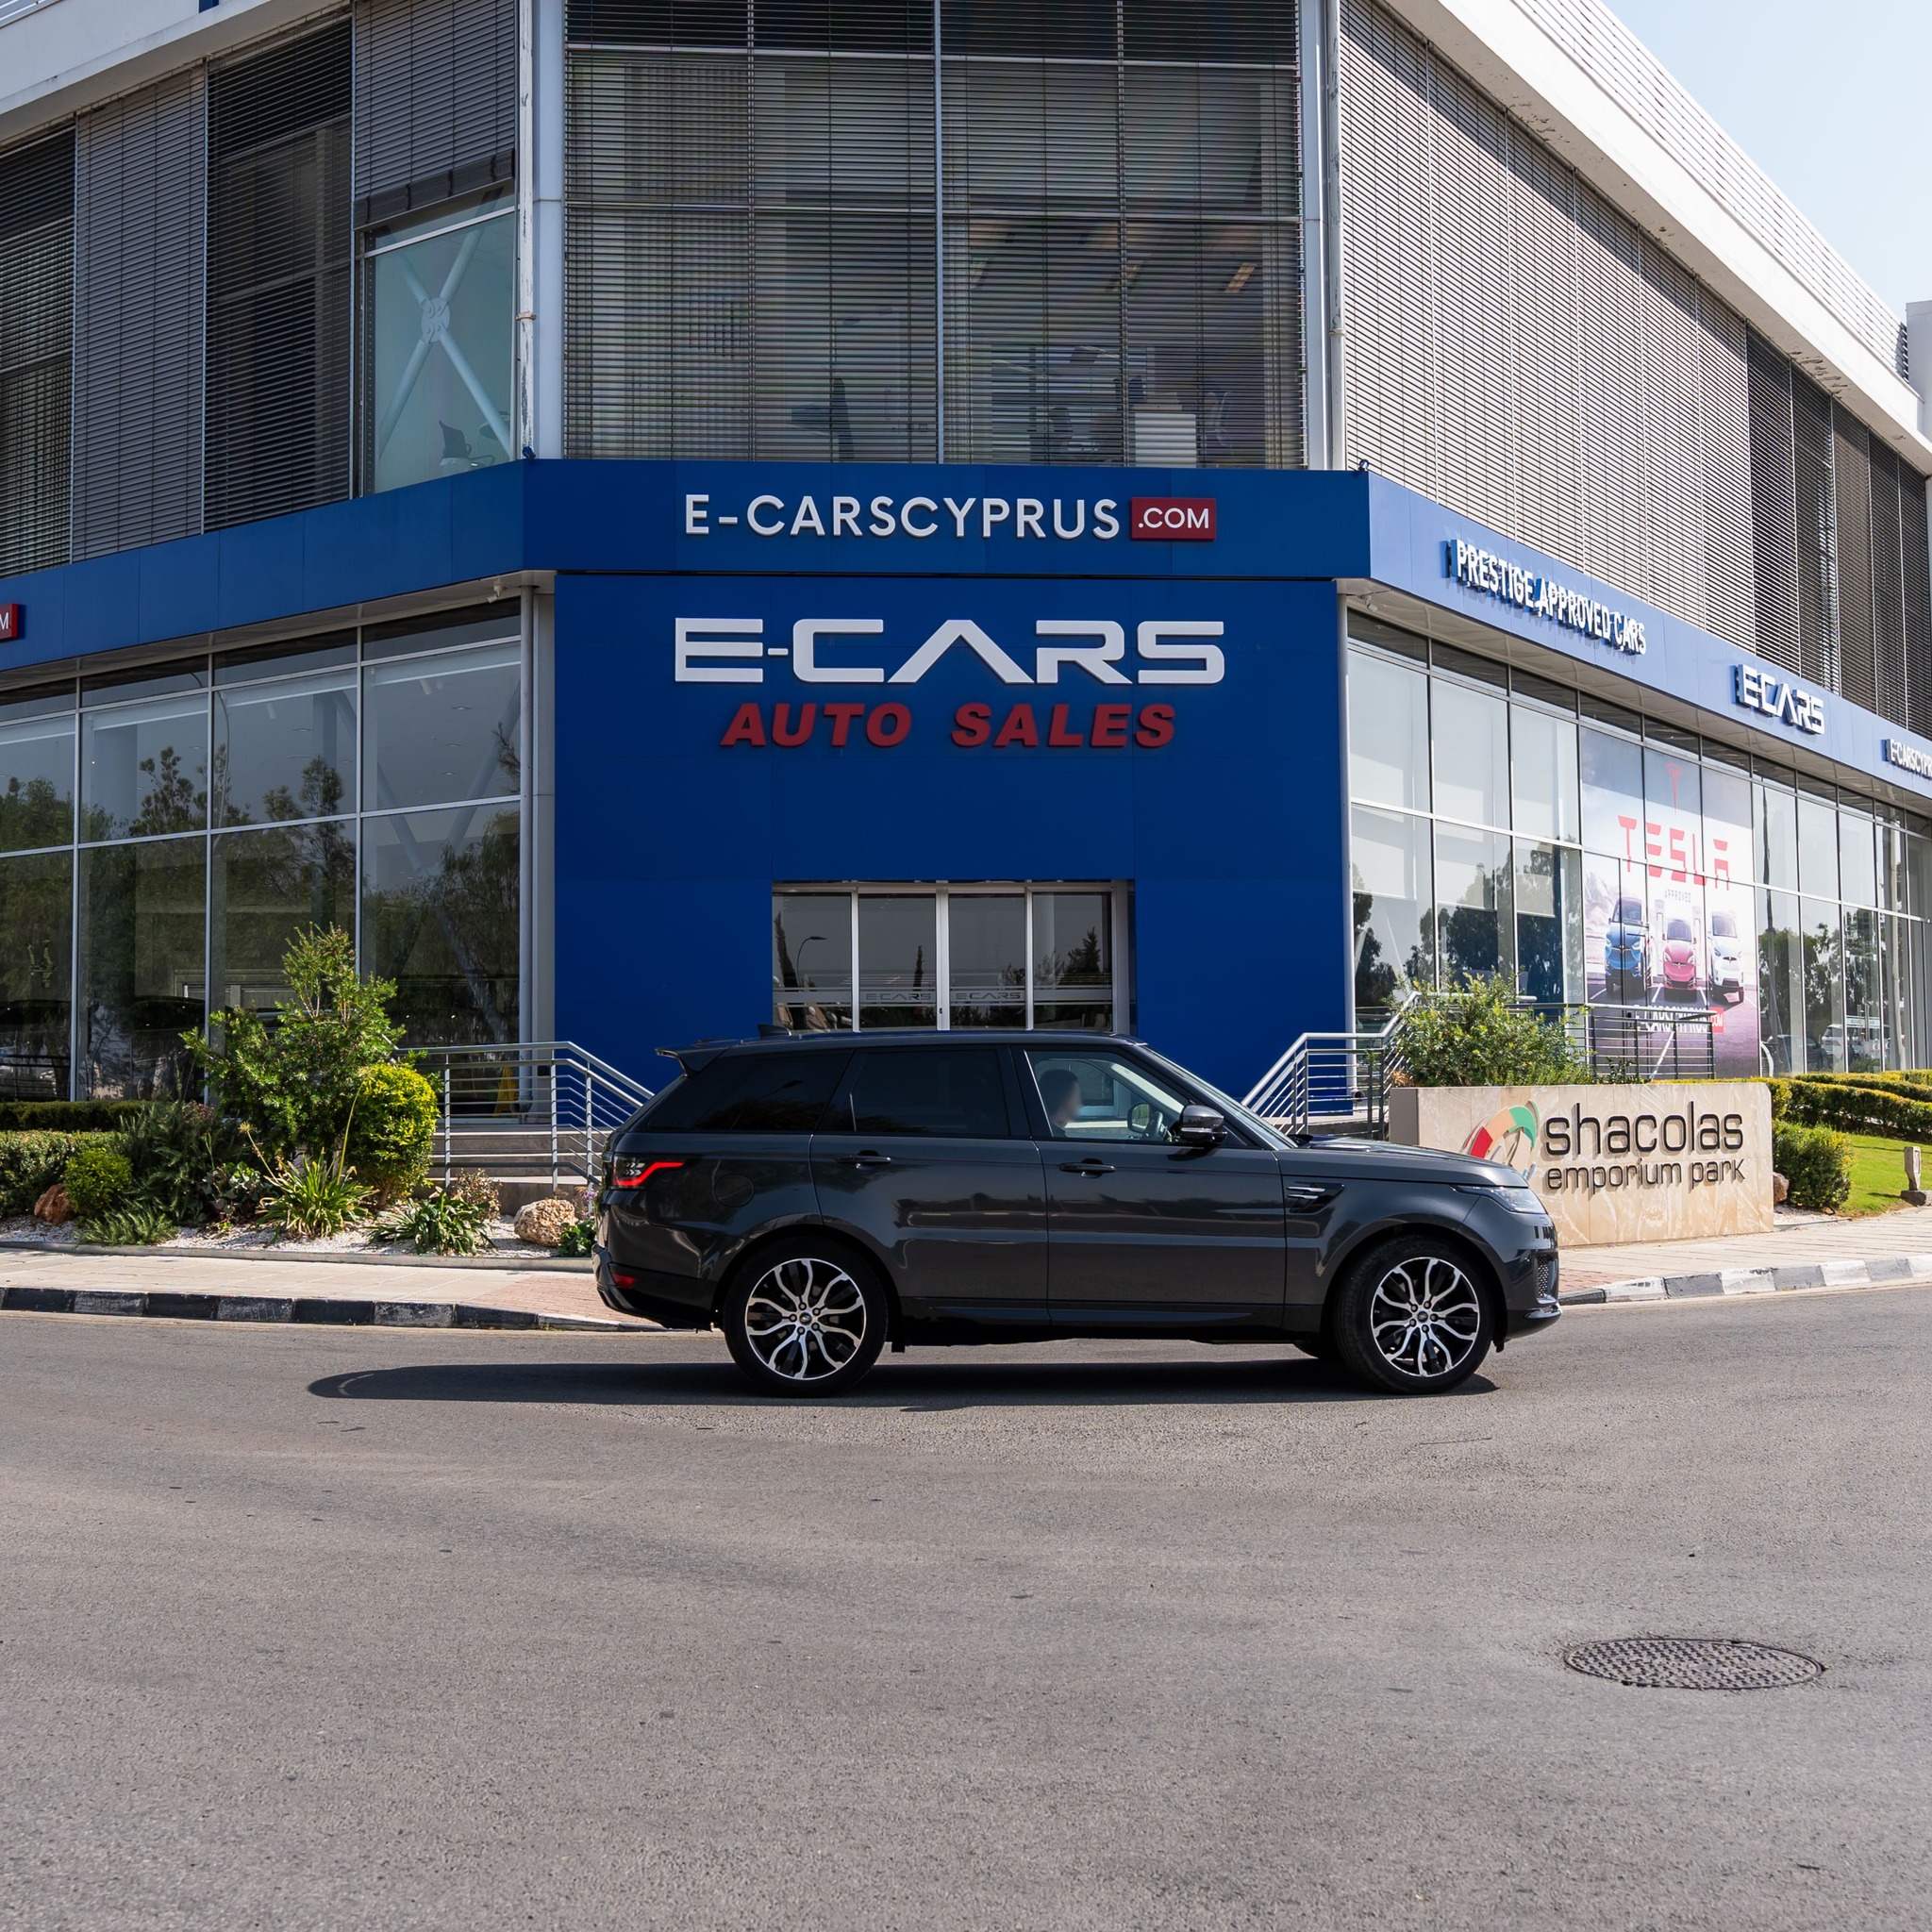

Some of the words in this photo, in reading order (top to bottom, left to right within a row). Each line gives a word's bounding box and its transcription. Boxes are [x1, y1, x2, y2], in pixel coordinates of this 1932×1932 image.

[686, 494, 1120, 539] E-CARSCYPRUS
[1138, 507, 1209, 529] .COM
[1454, 539, 1534, 608] PRESTIGE
[1535, 577, 1611, 642] APPROVED
[1614, 610, 1646, 656] CARS
[675, 617, 1224, 685] E-CARS
[721, 702, 912, 748] AUTO
[951, 703, 1176, 749] SALES
[1617, 814, 1730, 891] TESLA
[1545, 1101, 1743, 1156] shacolas
[1547, 1158, 1682, 1194] emporium
[1691, 1158, 1745, 1190] park
